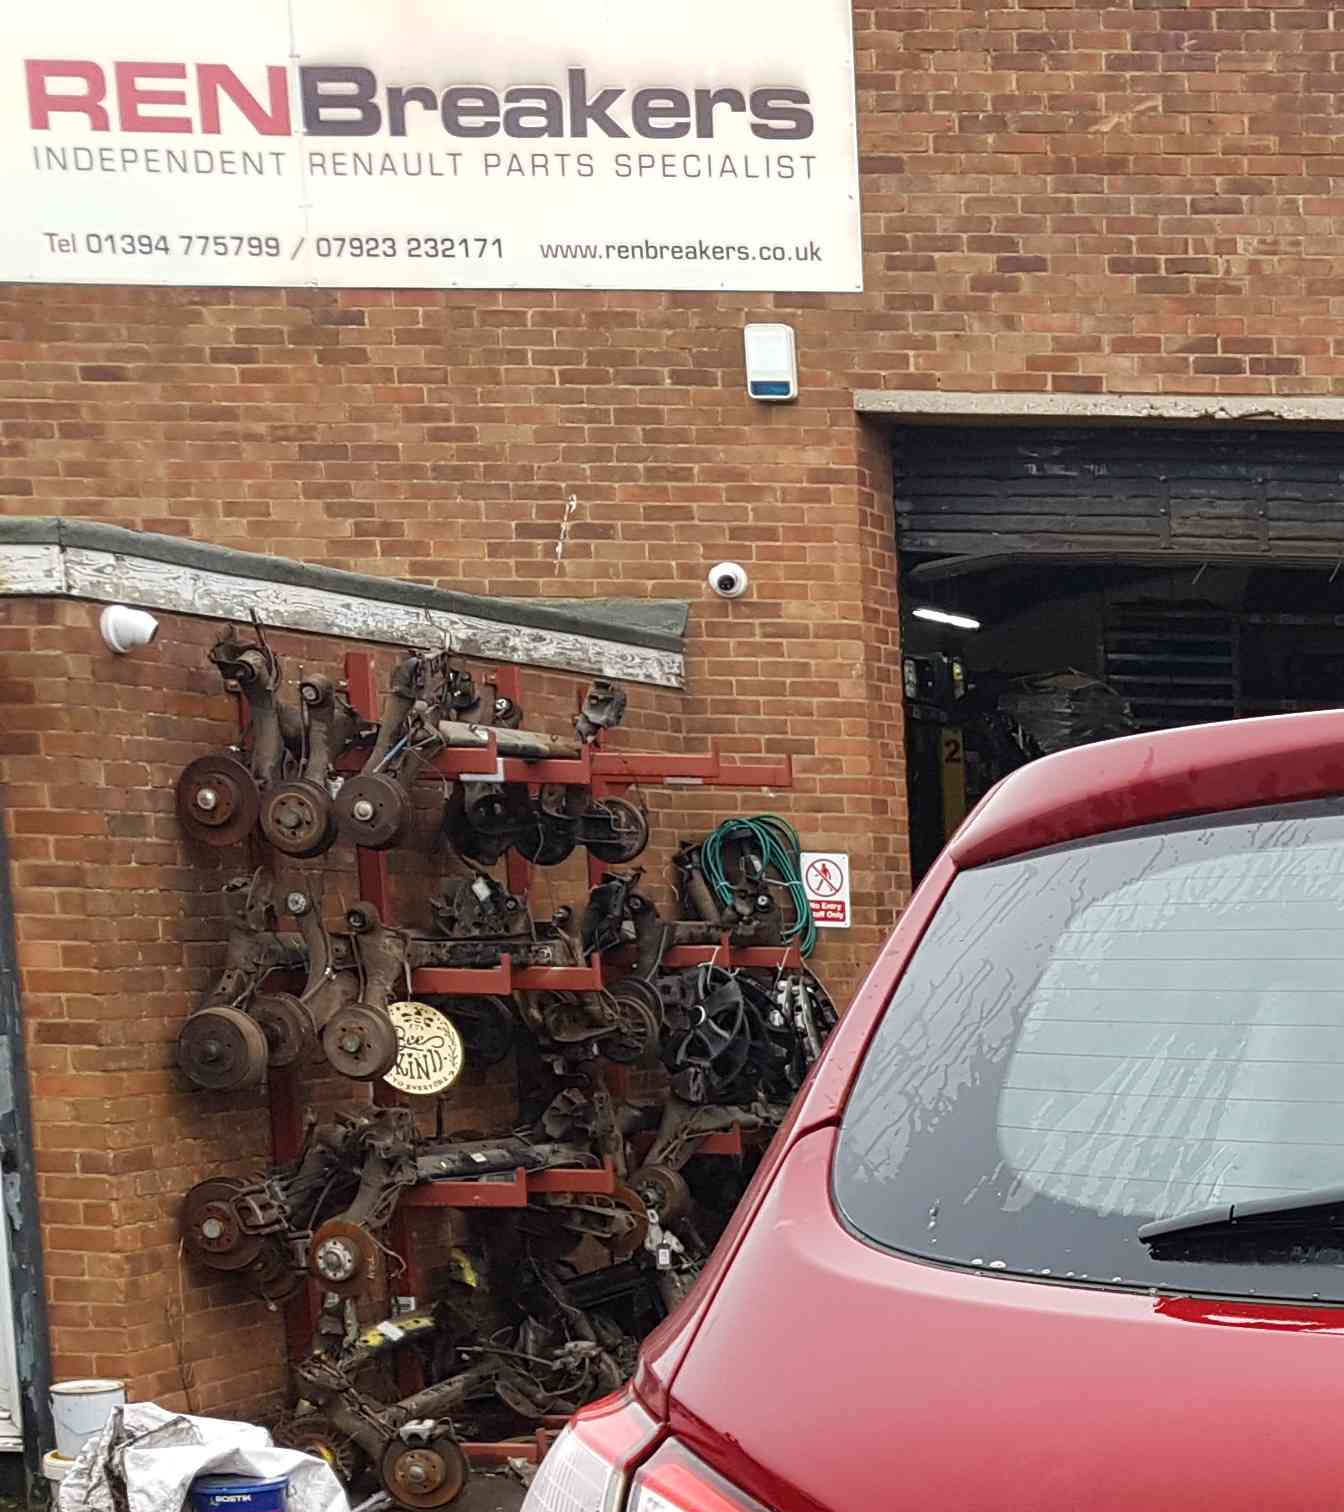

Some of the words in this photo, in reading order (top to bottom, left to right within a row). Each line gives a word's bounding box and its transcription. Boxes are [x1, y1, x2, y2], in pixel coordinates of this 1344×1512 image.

[24, 59, 815, 141] RENBreakers
[34, 146, 285, 176] INDEPENDENT
[309, 152, 462, 178] RENAULT
[484, 153, 595, 178] PARTS
[615, 153, 818, 180] SPECIALIST
[44, 231, 77, 254] Tel
[85, 233, 170, 256] 01394
[178, 235, 281, 258] 775799
[315, 237, 397, 259] 07923
[406, 237, 504, 260] 232171
[539, 239, 823, 263] www.renbreakers.co.uk
[943, 739, 961, 764] 2
[822, 902, 843, 912] Entry
[826, 911, 844, 920] Only
